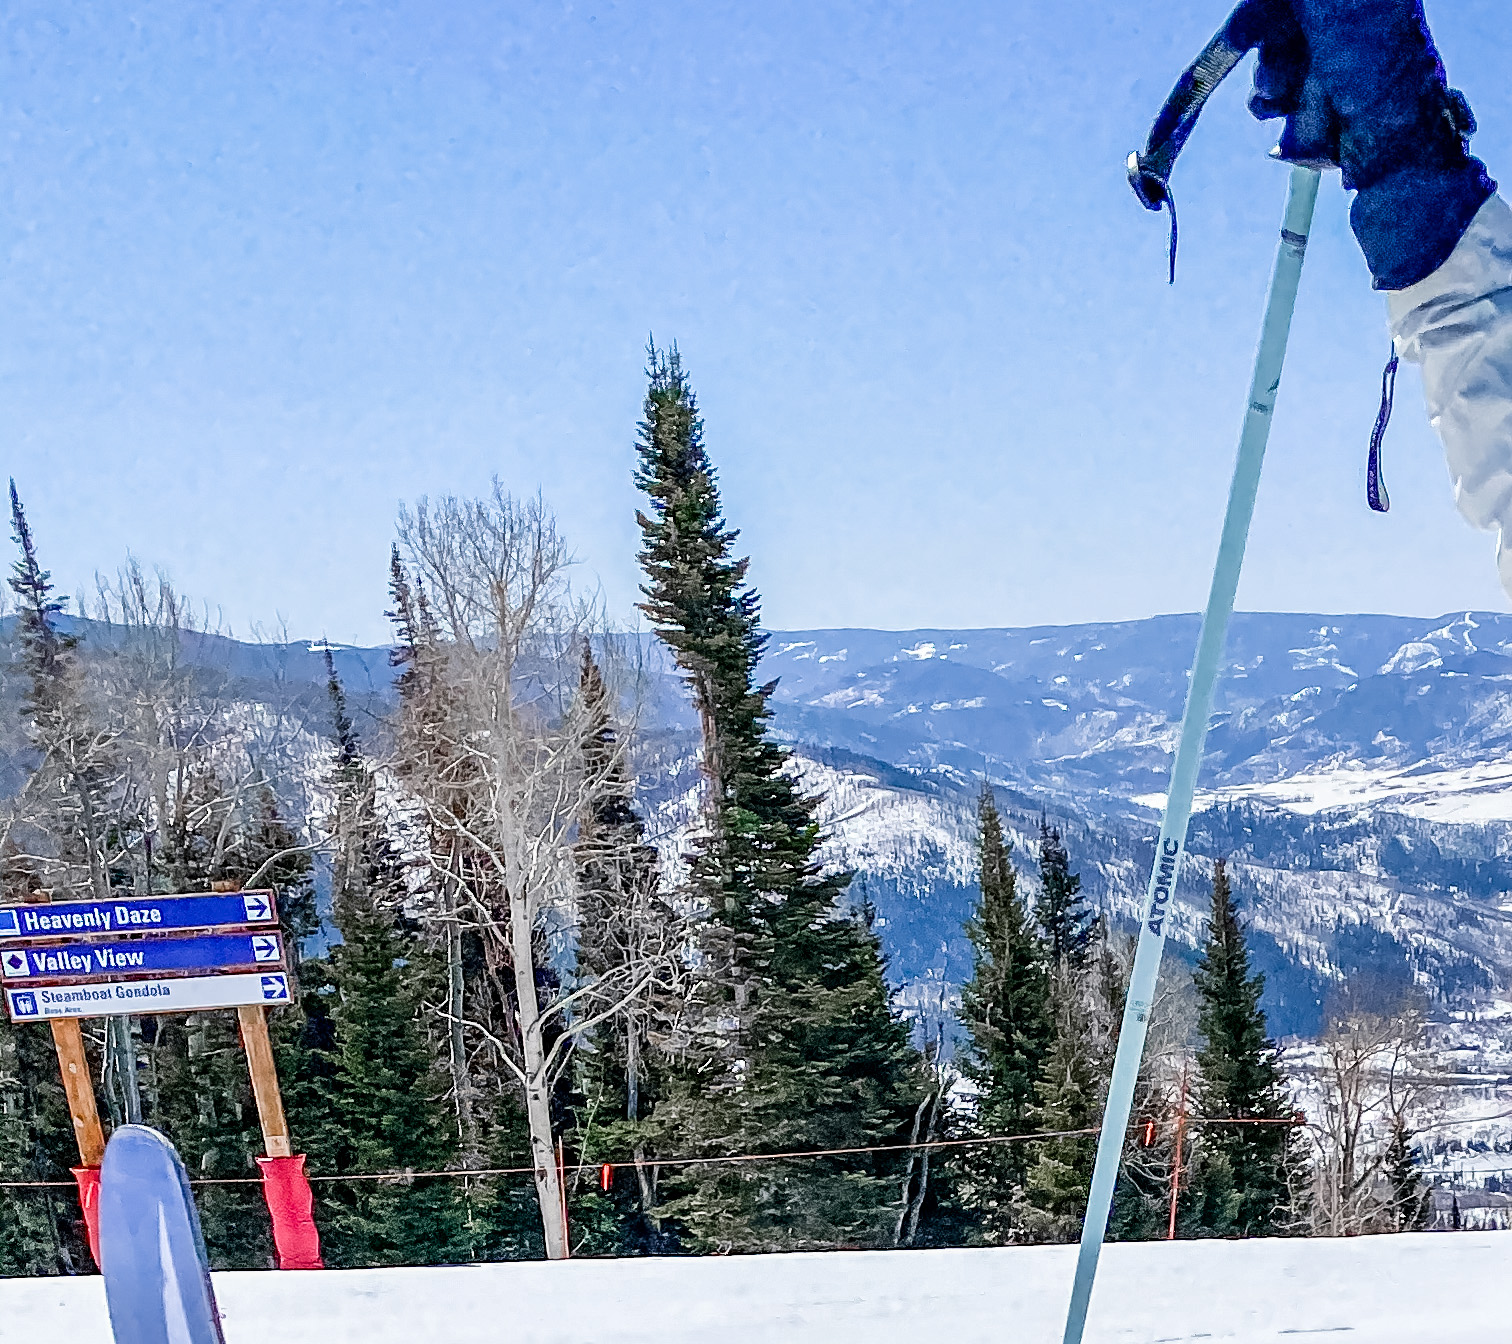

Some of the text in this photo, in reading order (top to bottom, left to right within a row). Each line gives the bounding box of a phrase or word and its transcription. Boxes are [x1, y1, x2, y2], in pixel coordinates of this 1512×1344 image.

[1148, 838, 1178, 937] ATOMIC
[24, 906, 161, 930] Heavenly Daze
[32, 948, 144, 973] Valley View
[41, 983, 171, 1004] Steamboat Gondola
